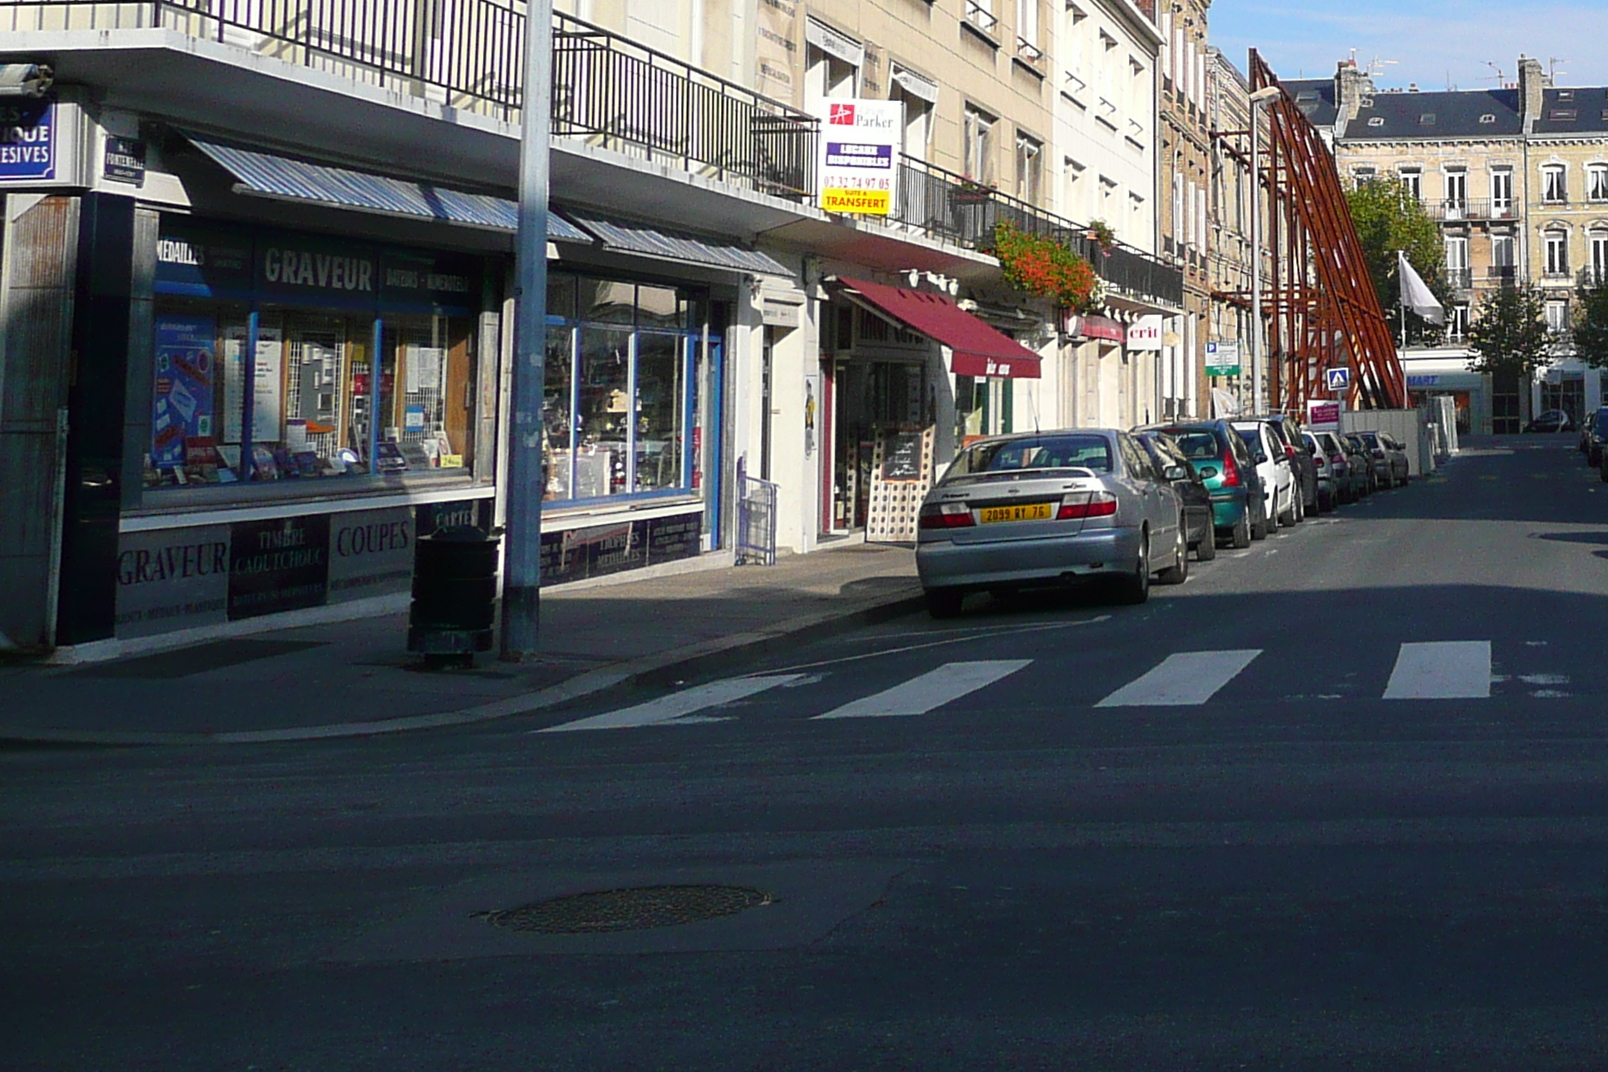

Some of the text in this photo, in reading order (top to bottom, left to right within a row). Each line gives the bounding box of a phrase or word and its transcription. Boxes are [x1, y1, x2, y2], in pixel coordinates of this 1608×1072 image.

[856, 114, 894, 129] Parker
[824, 176, 890, 191] 02 32 74 97 05
[826, 196, 886, 209] TRANSFERT
[265, 247, 372, 291] GRAVEUR
[987, 505, 1045, 521] 2099 RY 76
[258, 527, 306, 550] TIMBRE
[337, 520, 408, 557] COUPES
[600, 532, 641, 549] TROPHES
[117, 541, 226, 586] GRAVEUR
[234, 548, 325, 576] CAOUTCHOUC
